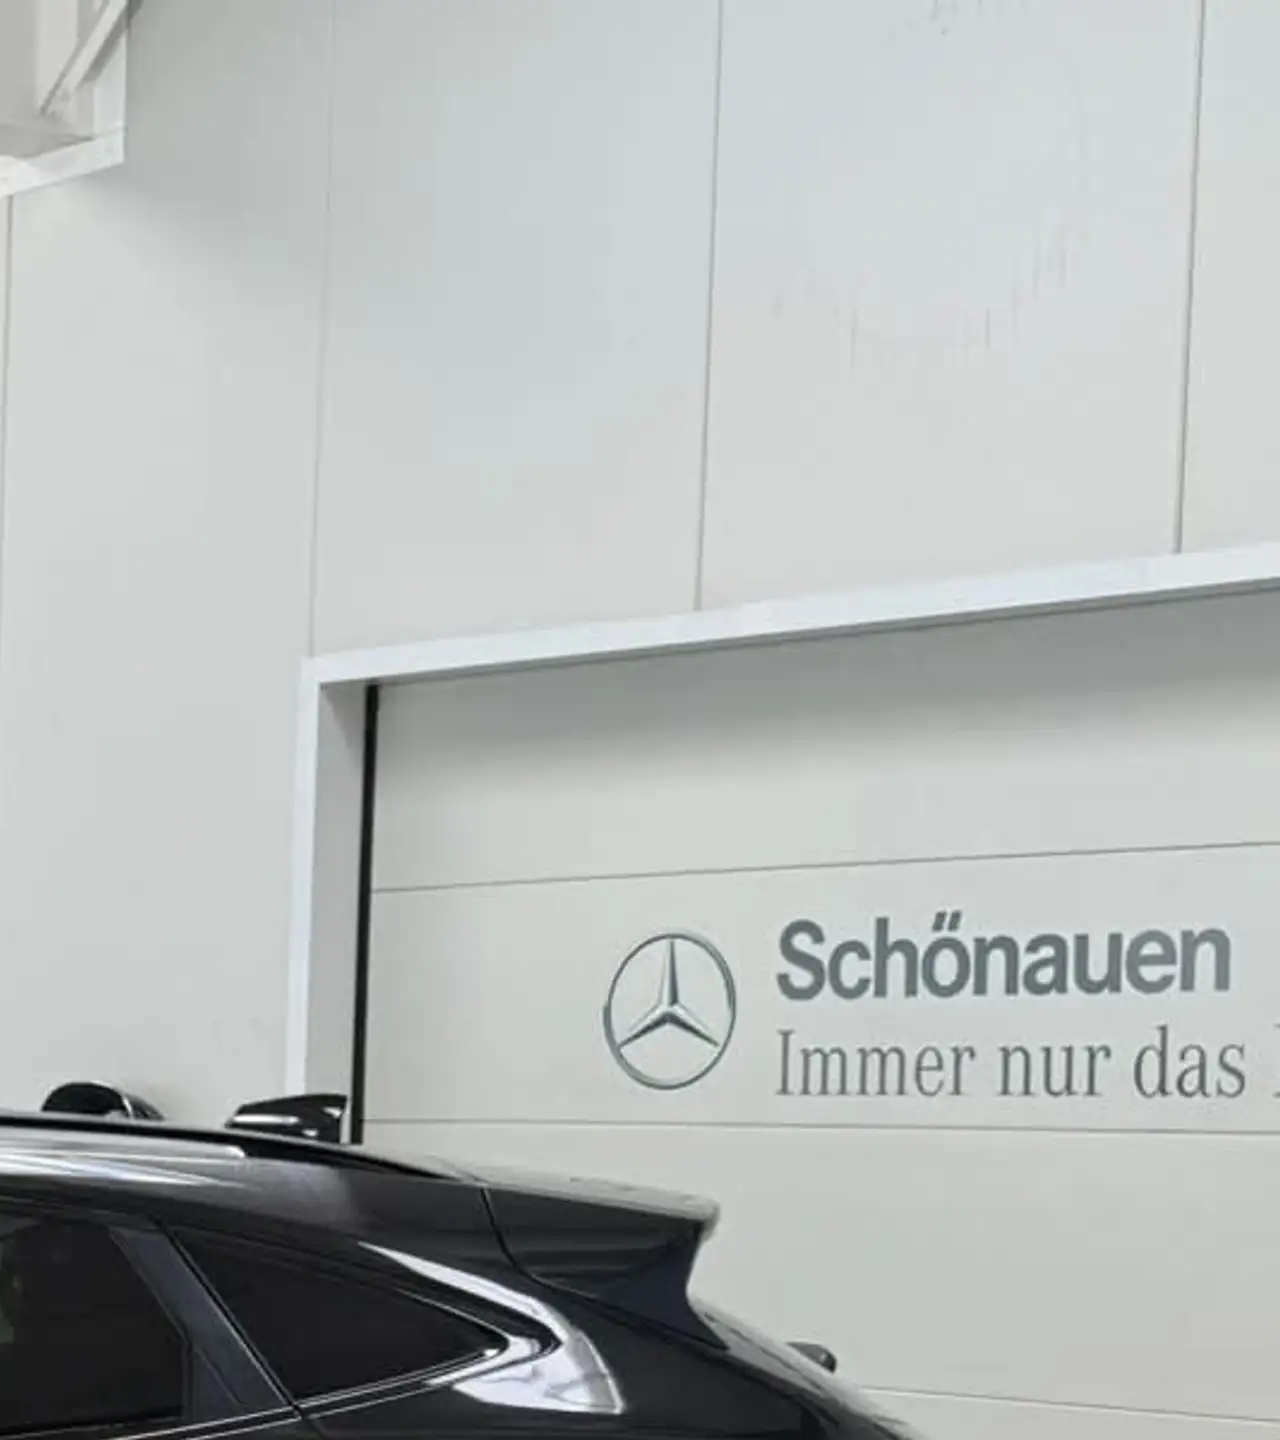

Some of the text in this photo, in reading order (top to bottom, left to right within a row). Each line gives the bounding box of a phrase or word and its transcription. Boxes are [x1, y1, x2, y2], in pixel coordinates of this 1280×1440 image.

[776, 911, 1231, 1001] Schönauen
[776, 1028, 976, 1098] Immer
[998, 1044, 1111, 1098] nur
[1133, 1021, 1246, 1099] das
